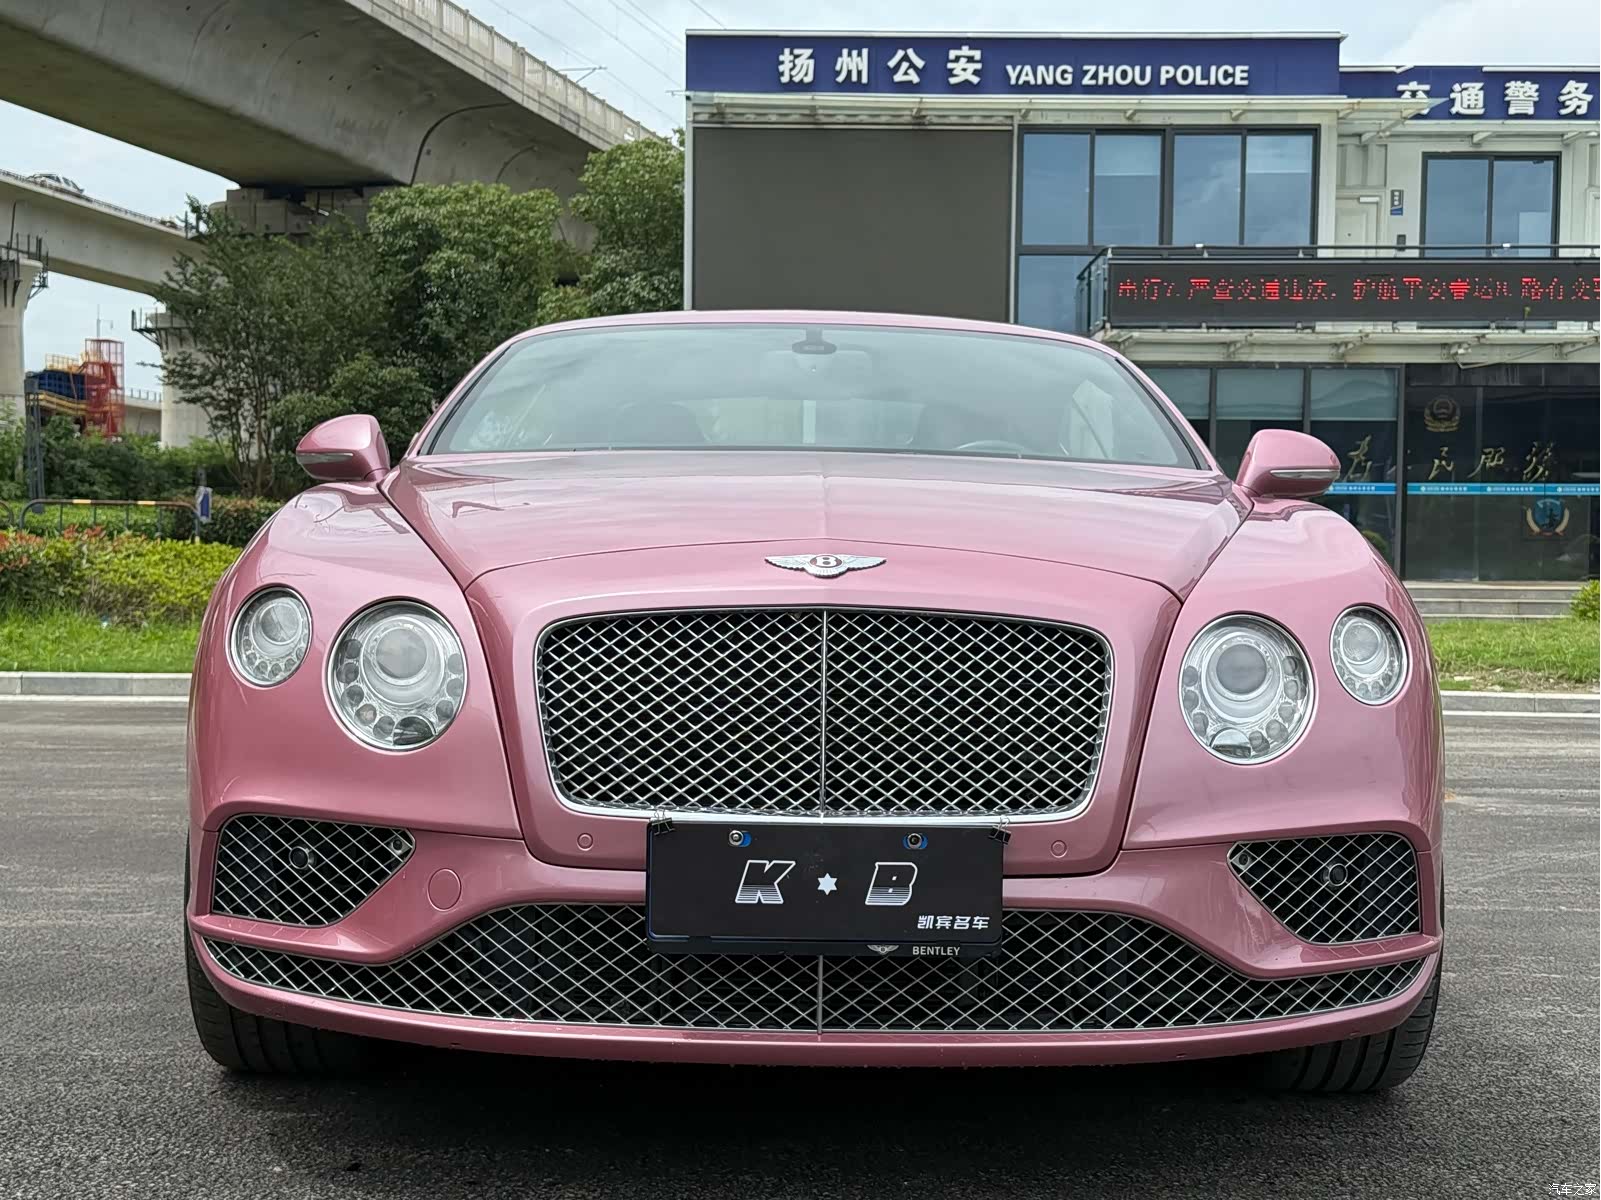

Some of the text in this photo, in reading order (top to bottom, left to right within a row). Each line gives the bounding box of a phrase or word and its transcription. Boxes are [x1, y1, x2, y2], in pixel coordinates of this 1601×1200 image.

[778, 45, 983, 86] 扬州公安
[1006, 64, 1250, 88] YANG ZHOU POLICE
[1397, 80, 1594, 116] 交通警务
[734, 859, 919, 906] K B
[917, 914, 991, 930] 凯宾名车
[912, 945, 961, 956] BENTLEY
